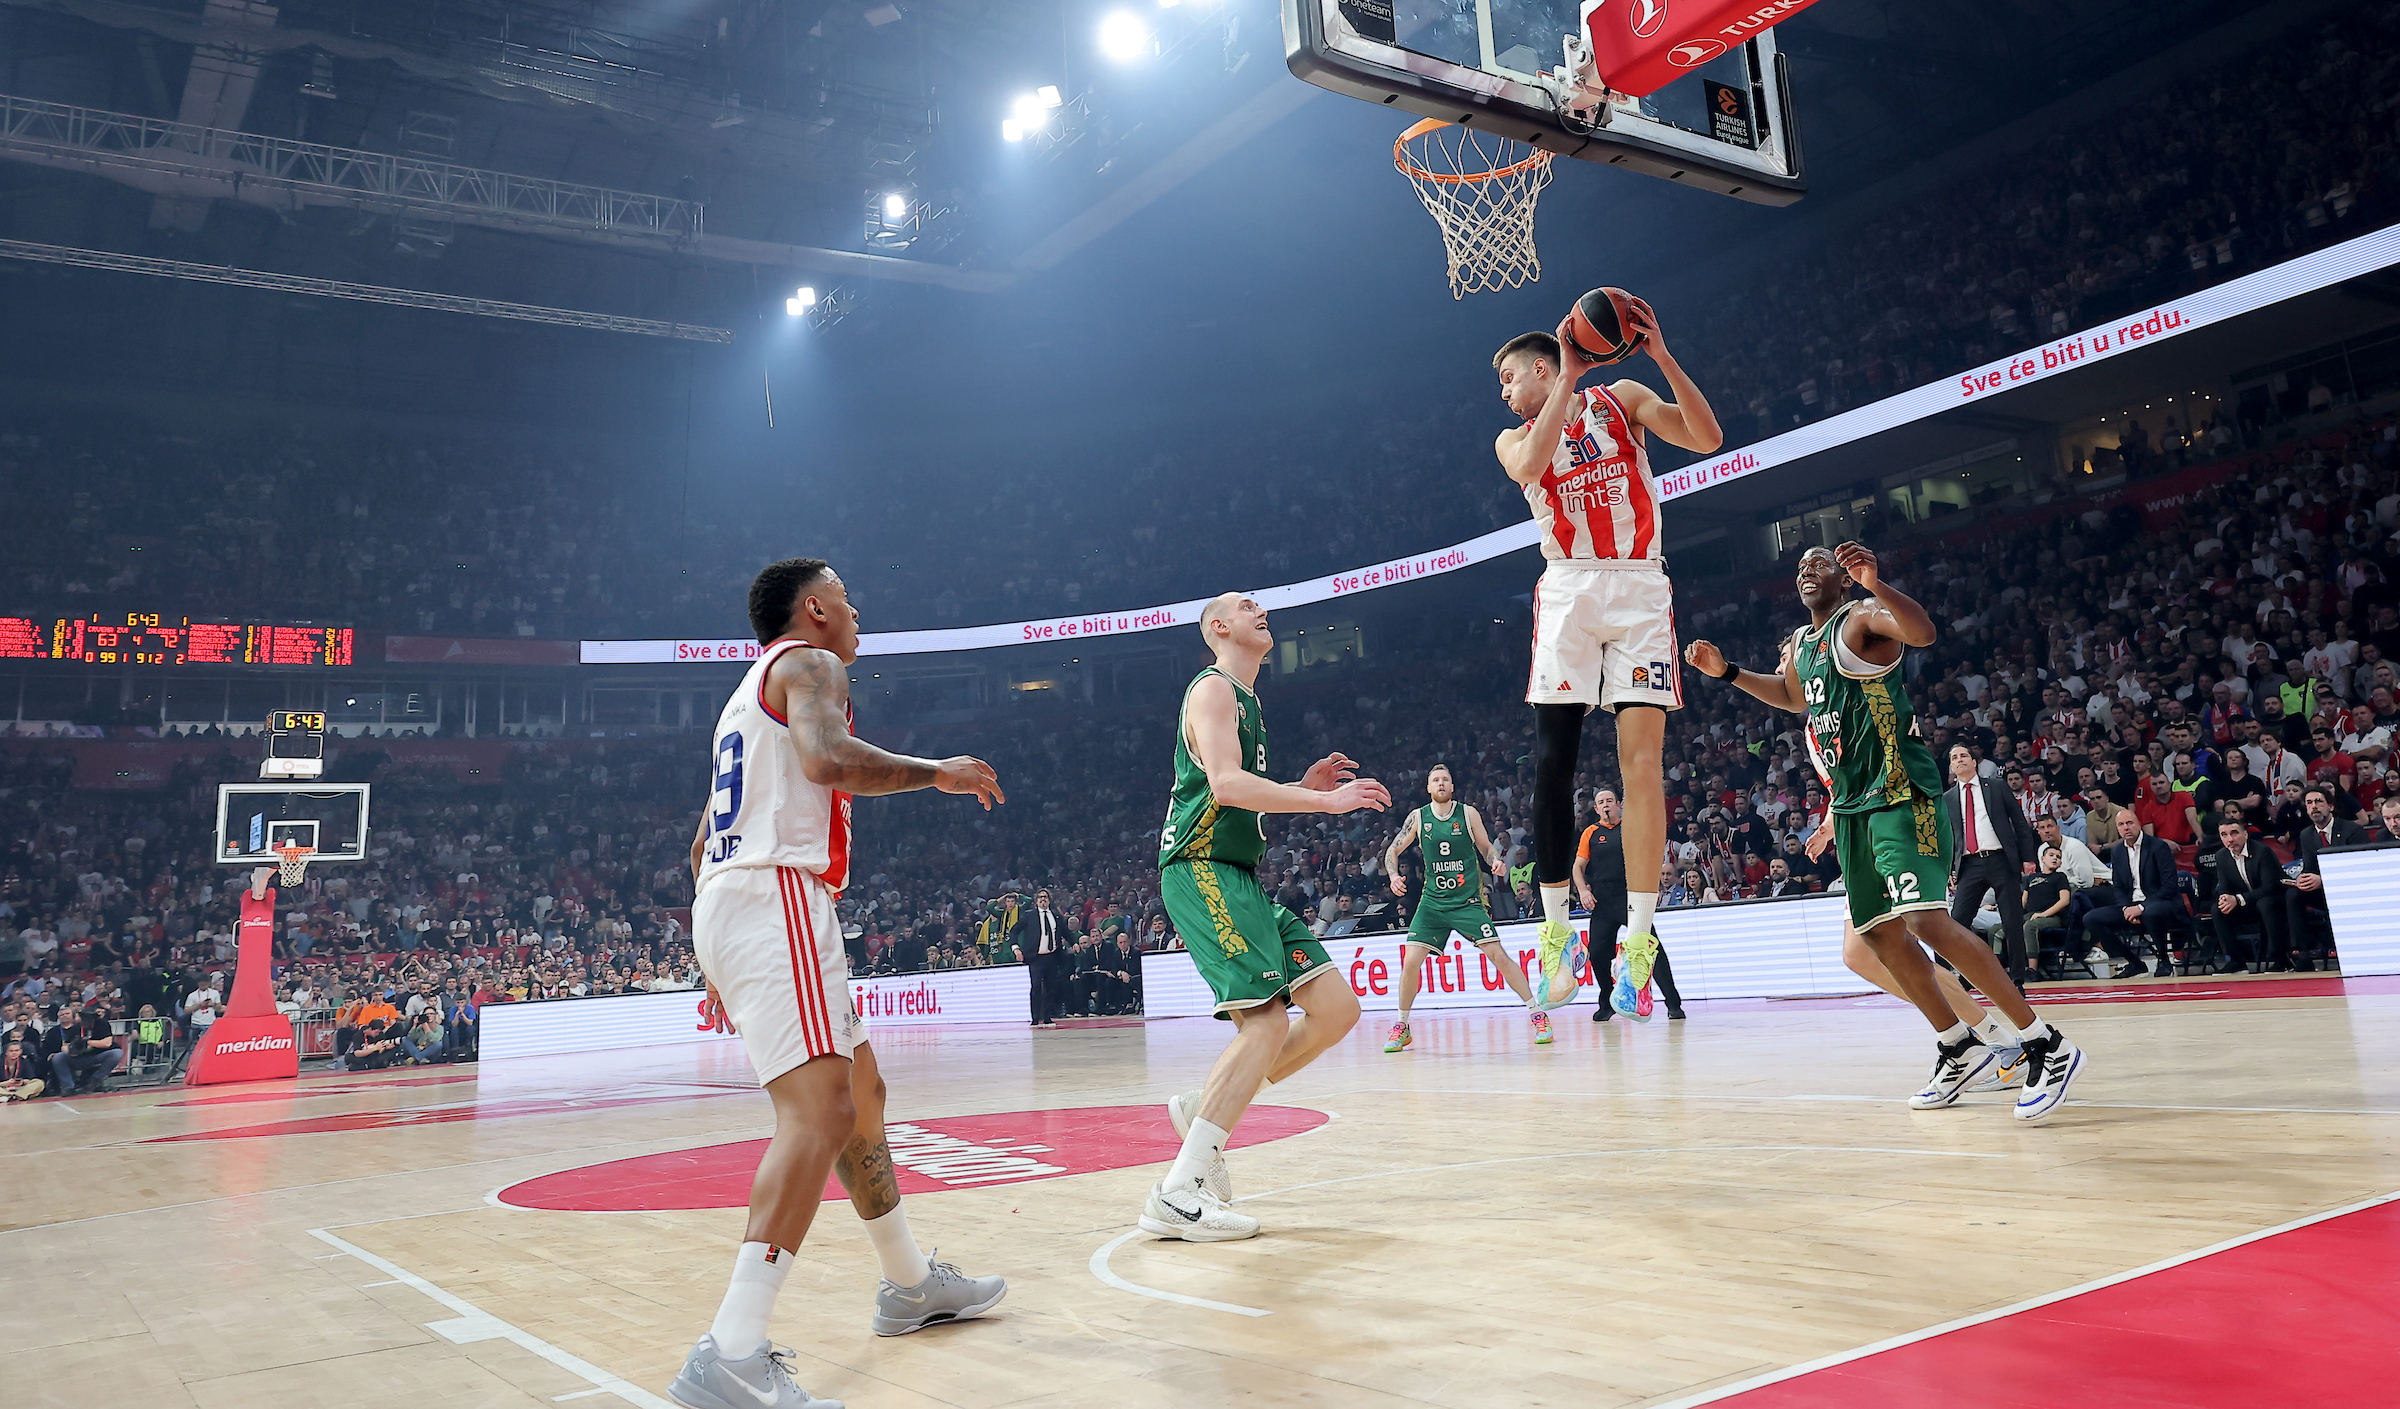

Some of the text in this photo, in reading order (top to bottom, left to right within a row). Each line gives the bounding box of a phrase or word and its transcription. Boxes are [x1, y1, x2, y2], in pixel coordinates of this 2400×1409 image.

[1715, 112, 1746, 128] TURKISH
[1716, 122, 1748, 137] AIRLINES
[1961, 310, 2190, 397] Sve će biti u redu.
[1565, 432, 1602, 468] 30
[1557, 462, 1628, 496] meridian
[1662, 453, 1760, 496] biti u redu.
[1568, 486, 1623, 512] mts
[1333, 550, 1468, 593] Sve će biti u redu.
[1023, 610, 1176, 640] Sve će biti u redu.
[97, 633, 118, 647] 63
[160, 635, 179, 648] 72
[679, 643, 761, 659] Sve će bi
[1804, 676, 1826, 706] 42
[285, 714, 323, 729] 6:43
[1439, 841, 1451, 856] 8
[1435, 874, 1466, 890] Go3
[1887, 871, 1921, 903] 42
[1480, 923, 1493, 938] 8
[1350, 947, 1388, 996] će
[856, 981, 941, 1017] iti u redu.
[215, 1036, 292, 1056] meridian
